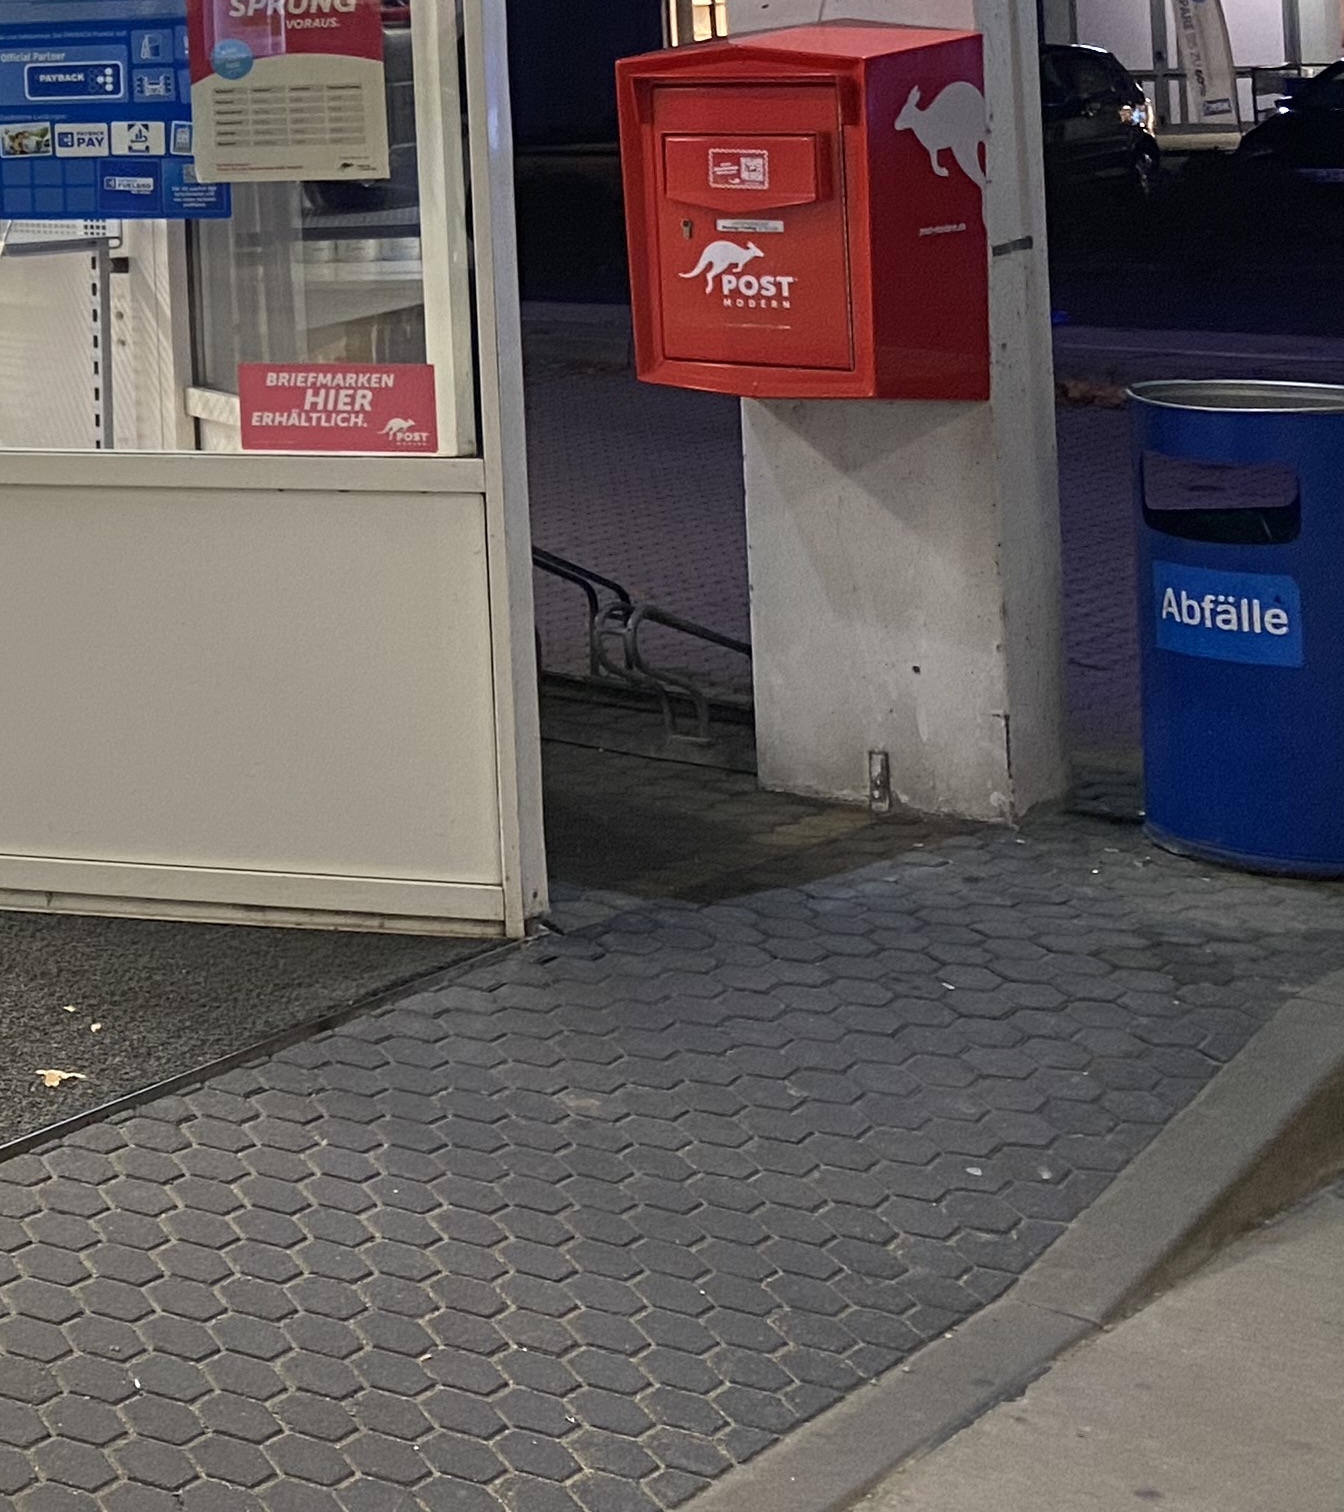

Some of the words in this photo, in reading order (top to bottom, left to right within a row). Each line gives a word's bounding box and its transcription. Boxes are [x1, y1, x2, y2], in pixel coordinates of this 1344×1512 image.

[287, 17, 341, 30] VORAUS.
[32, 51, 65, 61] Partner
[39, 73, 84, 83] PAYBACK
[76, 136, 105, 148] PAY
[721, 274, 795, 297] POST
[723, 298, 791, 309] MODERN
[266, 372, 395, 388] BRIEFMARKEN
[303, 389, 373, 411] HIER
[251, 409, 368, 428] ERHÄLTLICH.
[396, 432, 430, 442] POST
[1161, 587, 1290, 636] Abfälle
